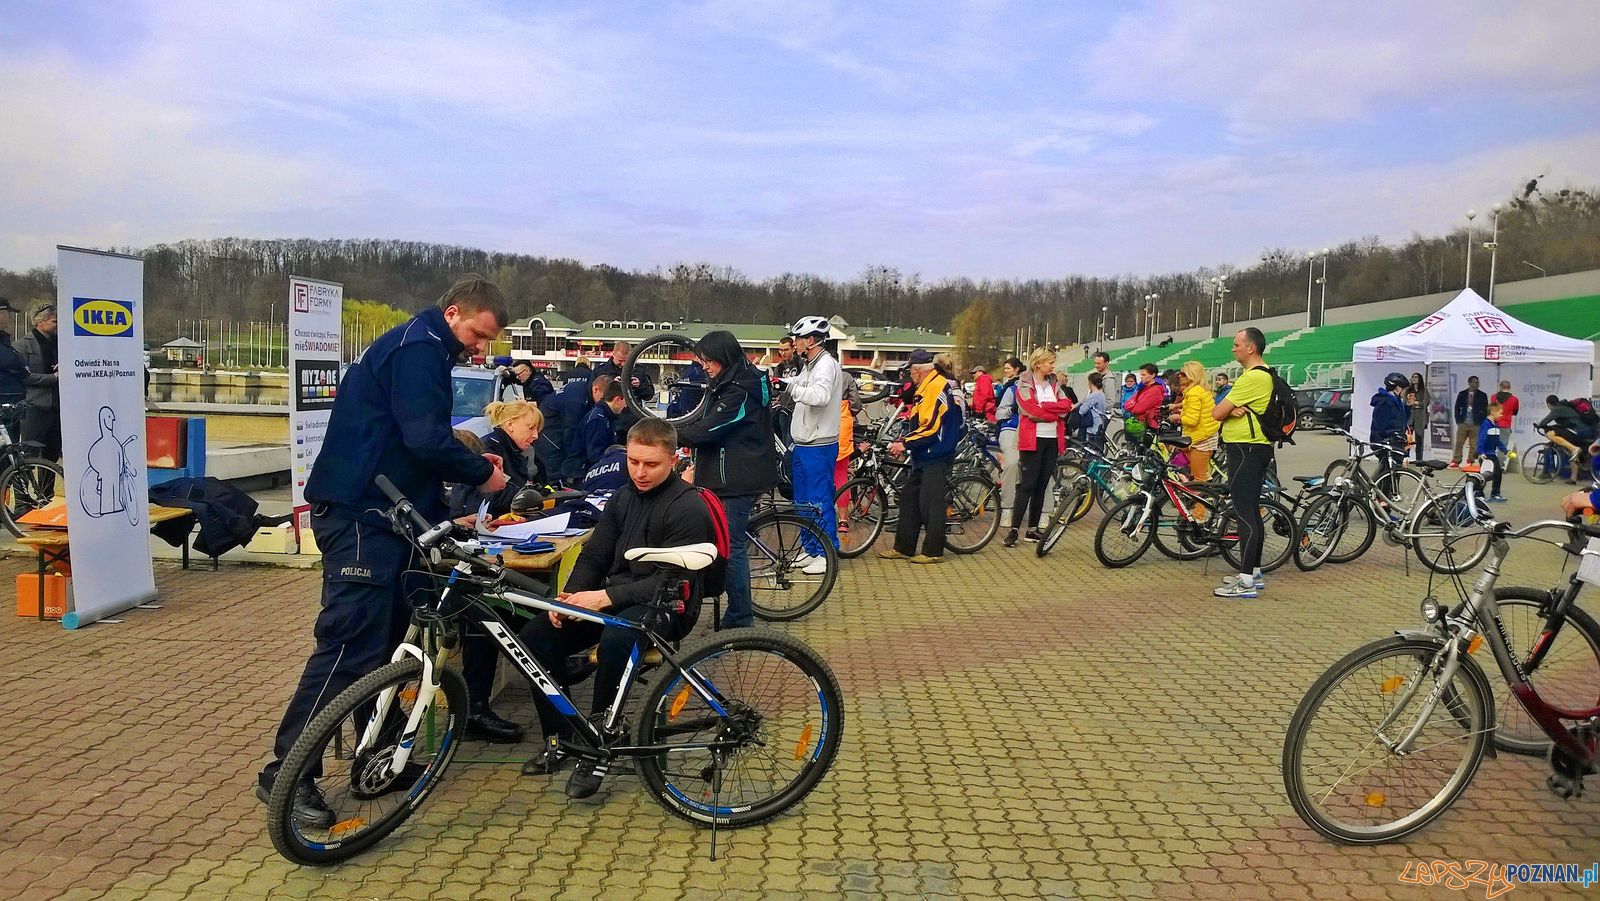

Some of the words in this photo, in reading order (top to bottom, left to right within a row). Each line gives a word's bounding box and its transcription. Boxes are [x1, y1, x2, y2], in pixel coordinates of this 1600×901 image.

[310, 285, 339, 298] FABRYKA
[310, 297, 333, 308] FORMY
[83, 309, 127, 325] IKEA
[584, 461, 620, 482] POLICJA
[340, 566, 371, 578] POLICJA
[496, 625, 550, 689] TREK
